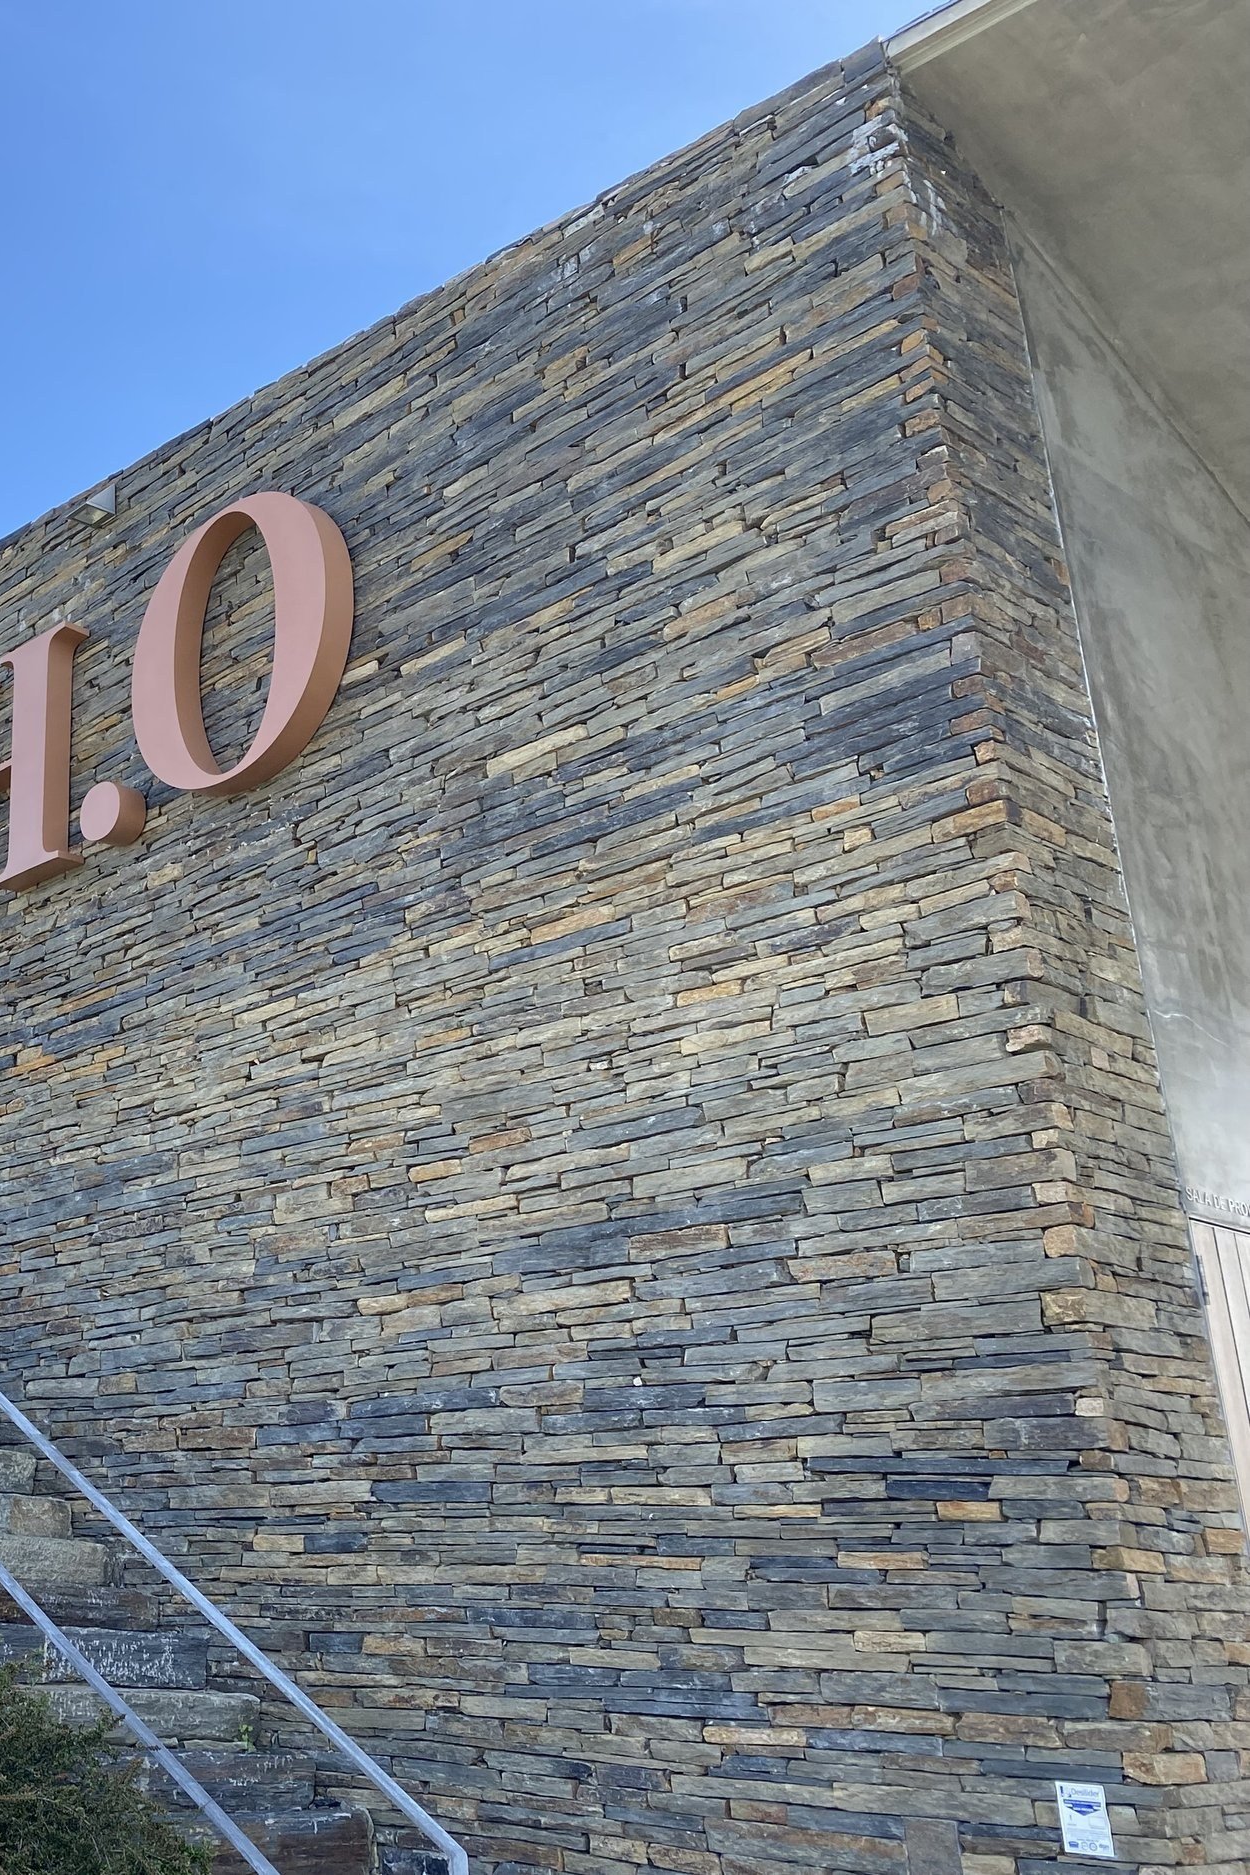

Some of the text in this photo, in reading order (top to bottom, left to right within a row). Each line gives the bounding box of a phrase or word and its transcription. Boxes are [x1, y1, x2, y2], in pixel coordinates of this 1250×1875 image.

[1185, 1186, 1250, 1217] SALA DE PRO
